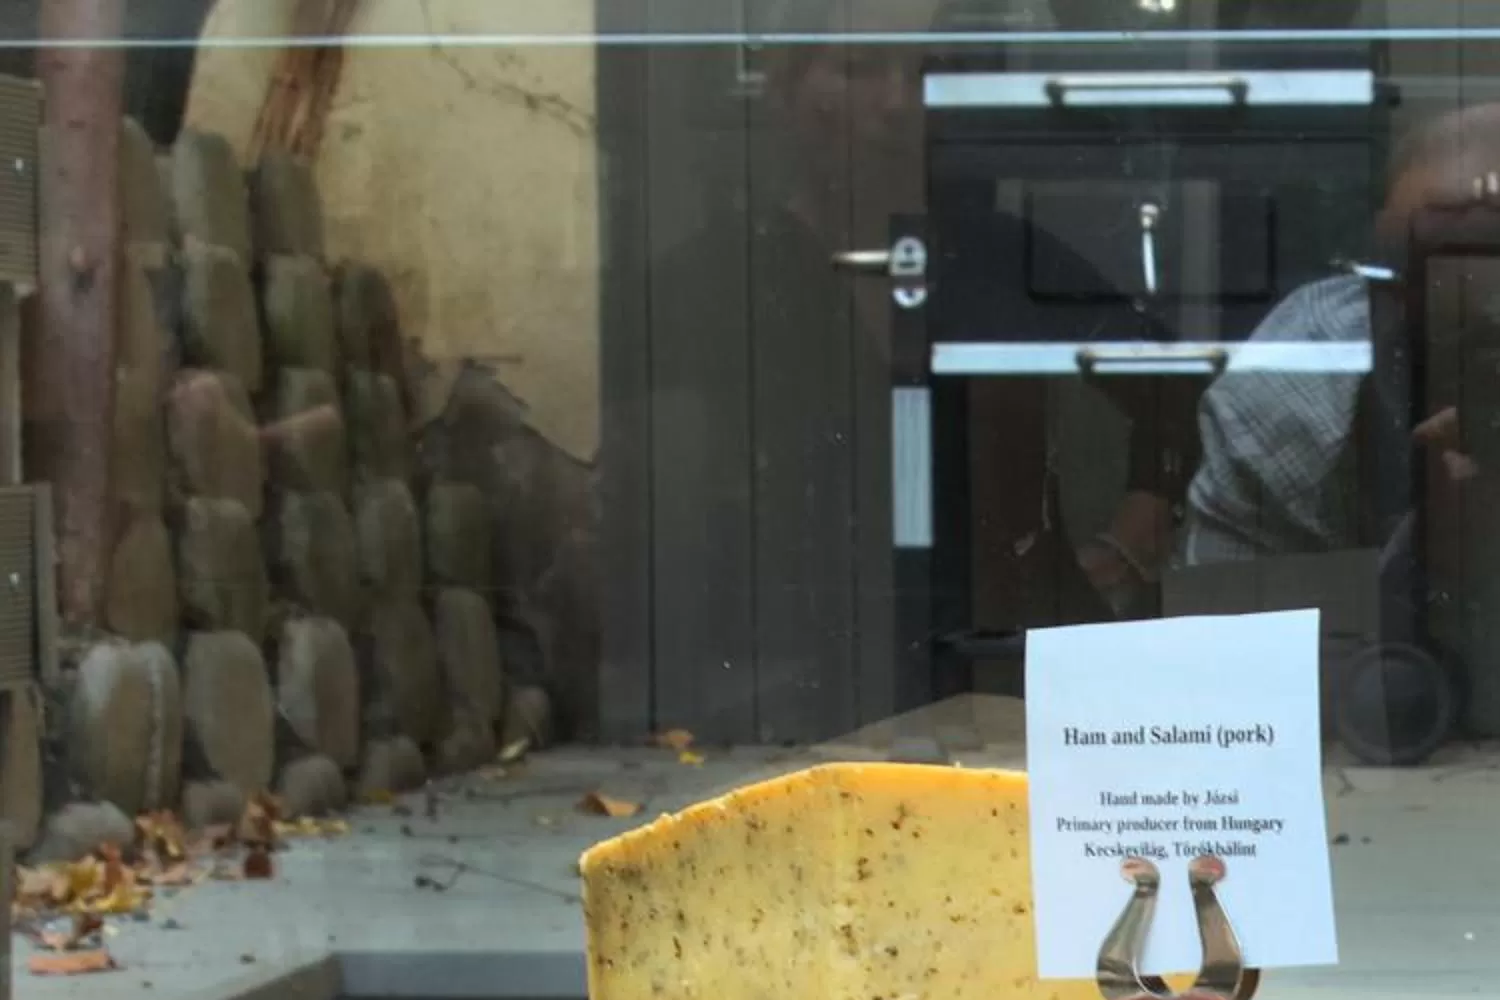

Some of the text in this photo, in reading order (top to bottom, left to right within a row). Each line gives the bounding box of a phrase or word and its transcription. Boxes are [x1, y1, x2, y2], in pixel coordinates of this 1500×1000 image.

[1063, 723, 1275, 748] Ham and Salami (pork)
[1099, 791, 1137, 805] Hand
[1141, 790, 1179, 805] made
[1183, 790, 1199, 807] by
[1056, 815, 1284, 835] Primary producer from Hungary
